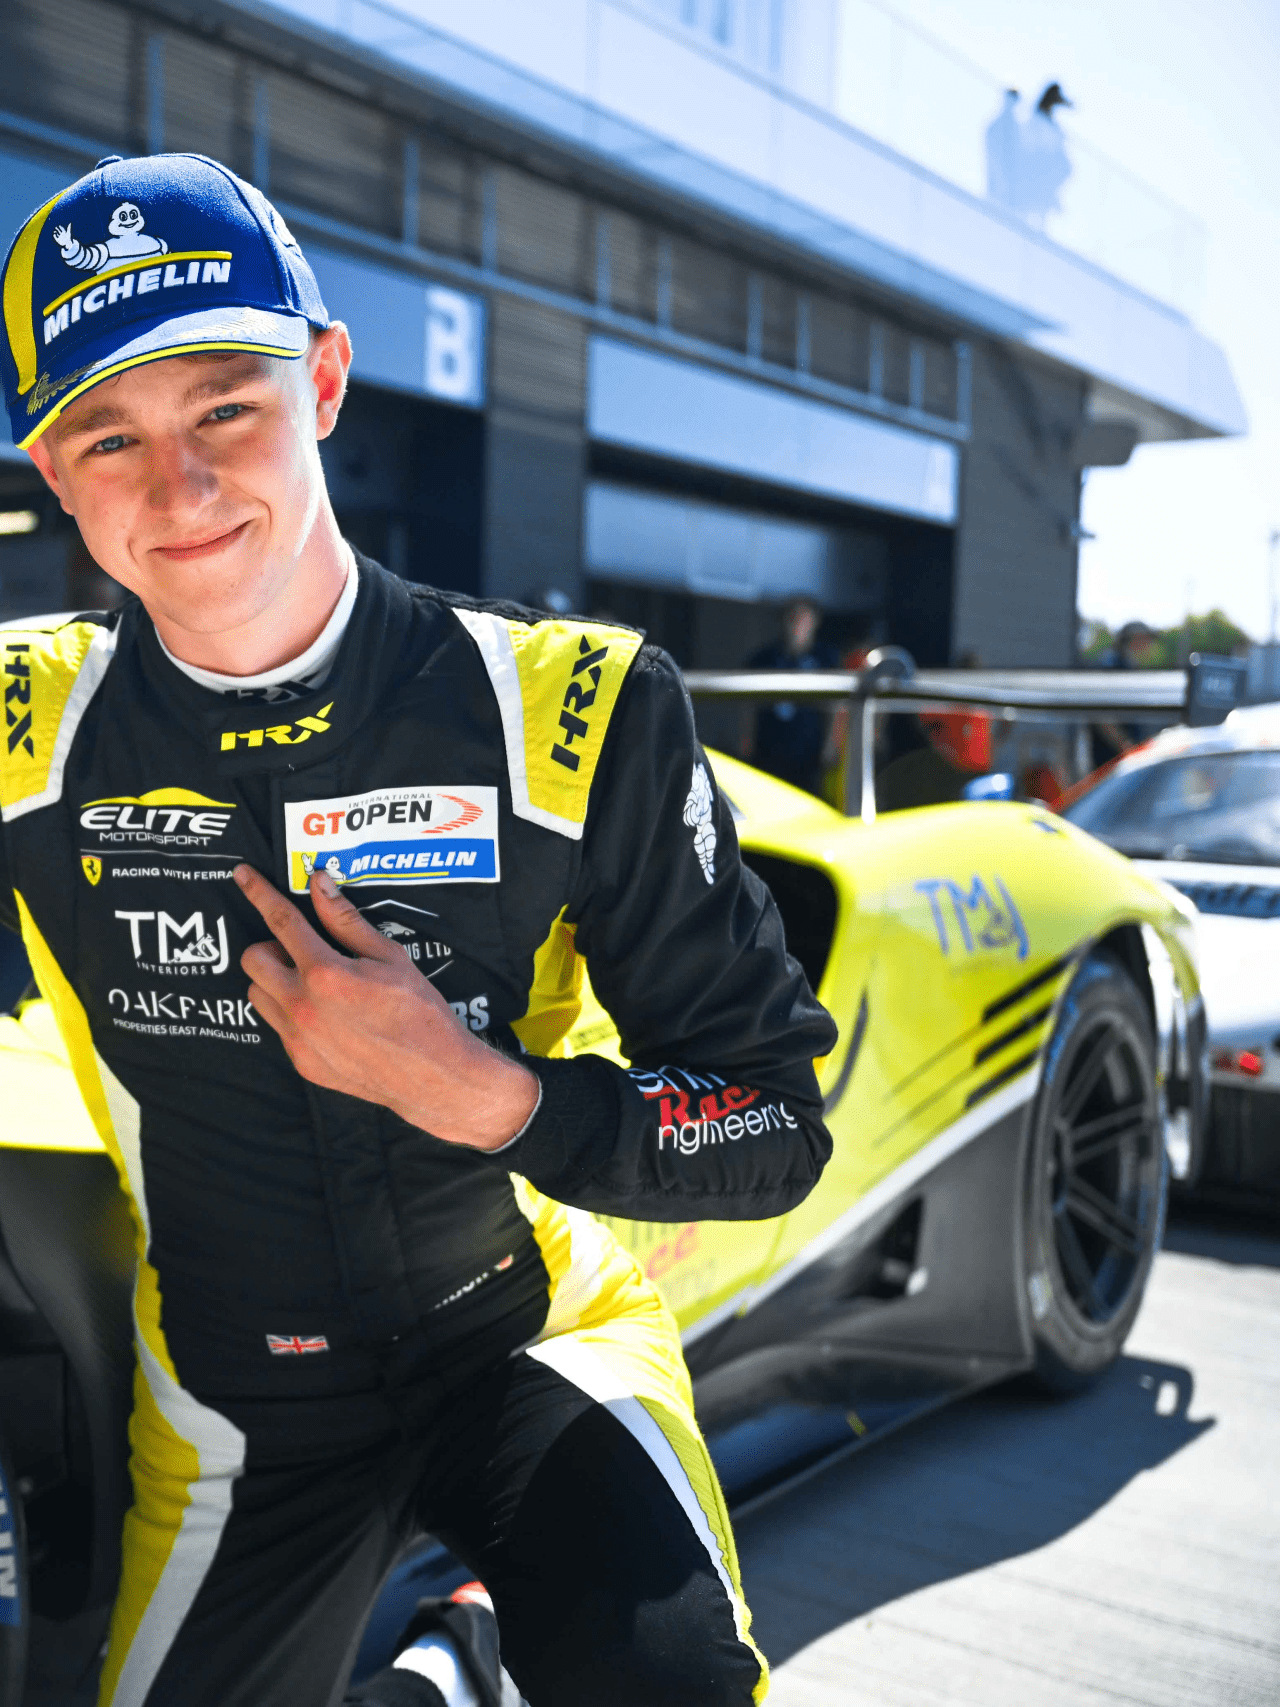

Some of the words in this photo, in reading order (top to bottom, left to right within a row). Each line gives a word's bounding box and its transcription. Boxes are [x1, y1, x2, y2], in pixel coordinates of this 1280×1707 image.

[43, 261, 231, 345] MICHELIN
[5, 645, 34, 758] HRX
[550, 634, 609, 772] HRX
[221, 701, 334, 751] HRX
[349, 793, 432, 808] INTERNATIONAL
[80, 806, 231, 836] ELITE
[99, 832, 212, 847] MOTORSPORT
[112, 868, 160, 877] RACING
[162, 868, 191, 880] WITH
[194, 870, 234, 880] FERRA
[349, 851, 478, 875] MICHELIN
[114, 910, 229, 974] TMJ
[425, 942, 452, 958] LTD
[136, 961, 207, 976] INTERIORS
[112, 1018, 167, 1035] PROPERTIES
[169, 1025, 197, 1036] (EAST
[199, 1027, 239, 1042] ANGLIA)
[241, 1033, 261, 1044] LTD
